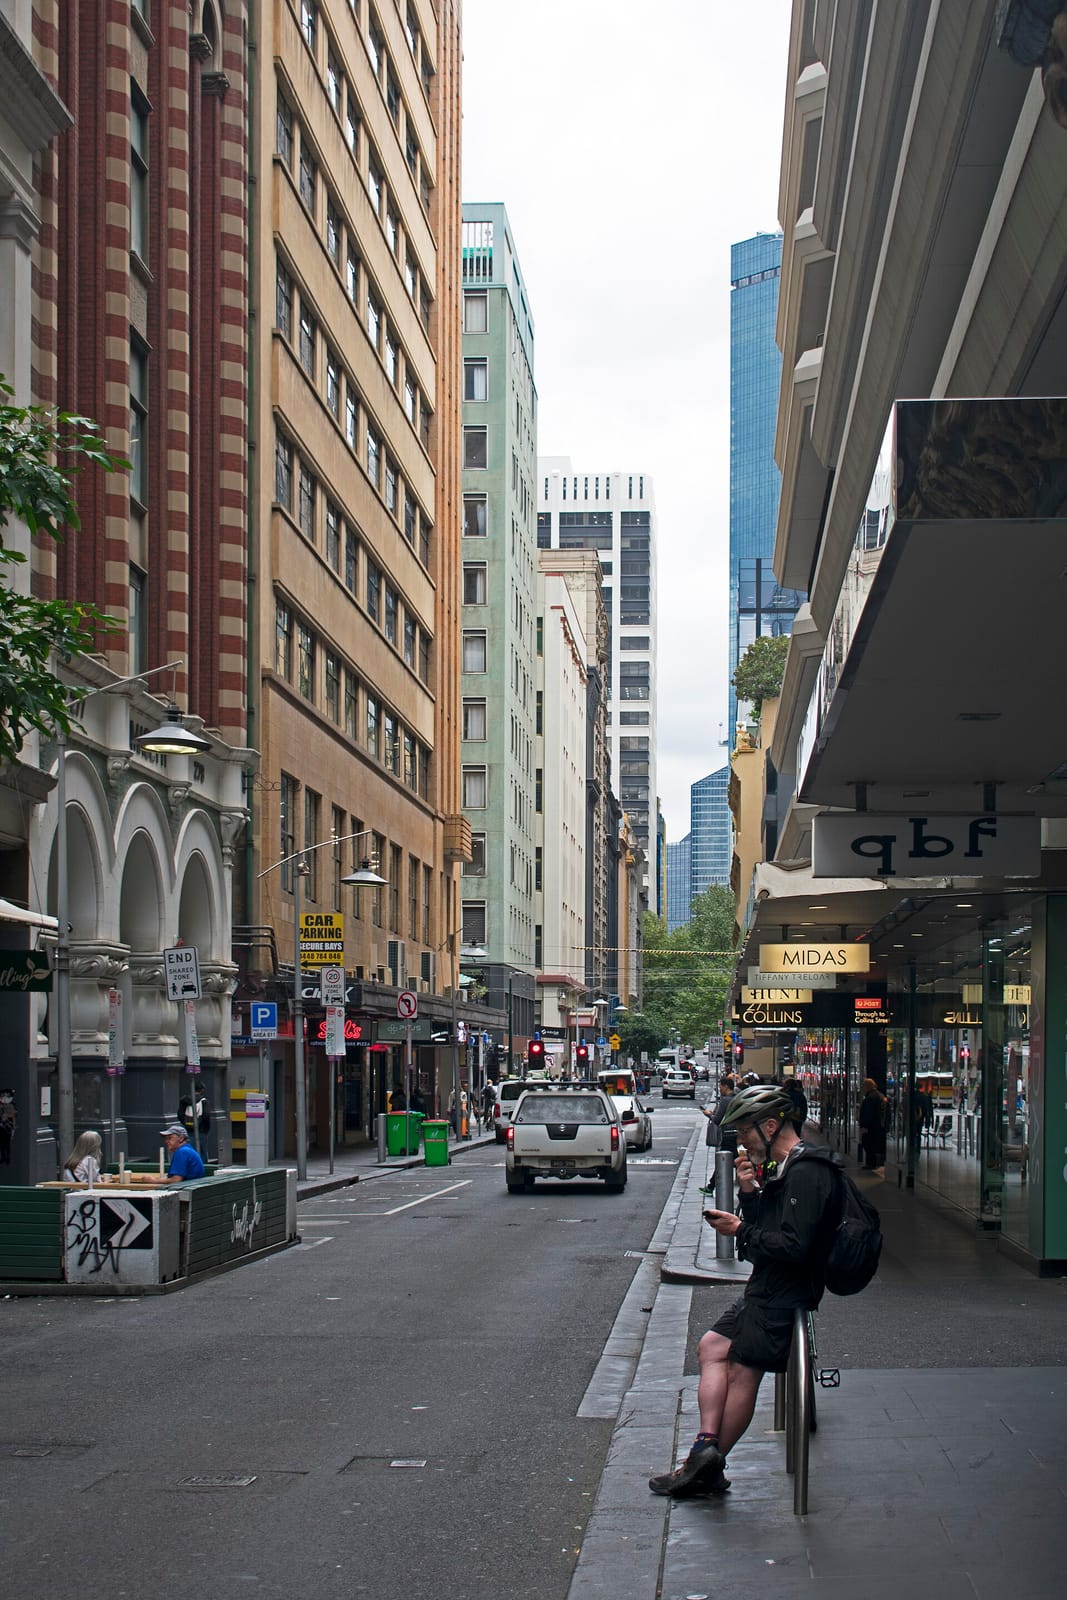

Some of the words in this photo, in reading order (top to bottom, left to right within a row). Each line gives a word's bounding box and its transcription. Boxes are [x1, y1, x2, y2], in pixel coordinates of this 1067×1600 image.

[851, 817, 997, 875] qbf
[305, 915, 333, 926] CAR
[325, 942, 342, 951] BAYS
[168, 952, 192, 964] END
[782, 949, 847, 966] MIDAS
[750, 988, 804, 999] HUNT
[257, 1007, 270, 1024] P
[743, 1010, 803, 1023] COLLINS
[854, 1010, 878, 1018] Through
